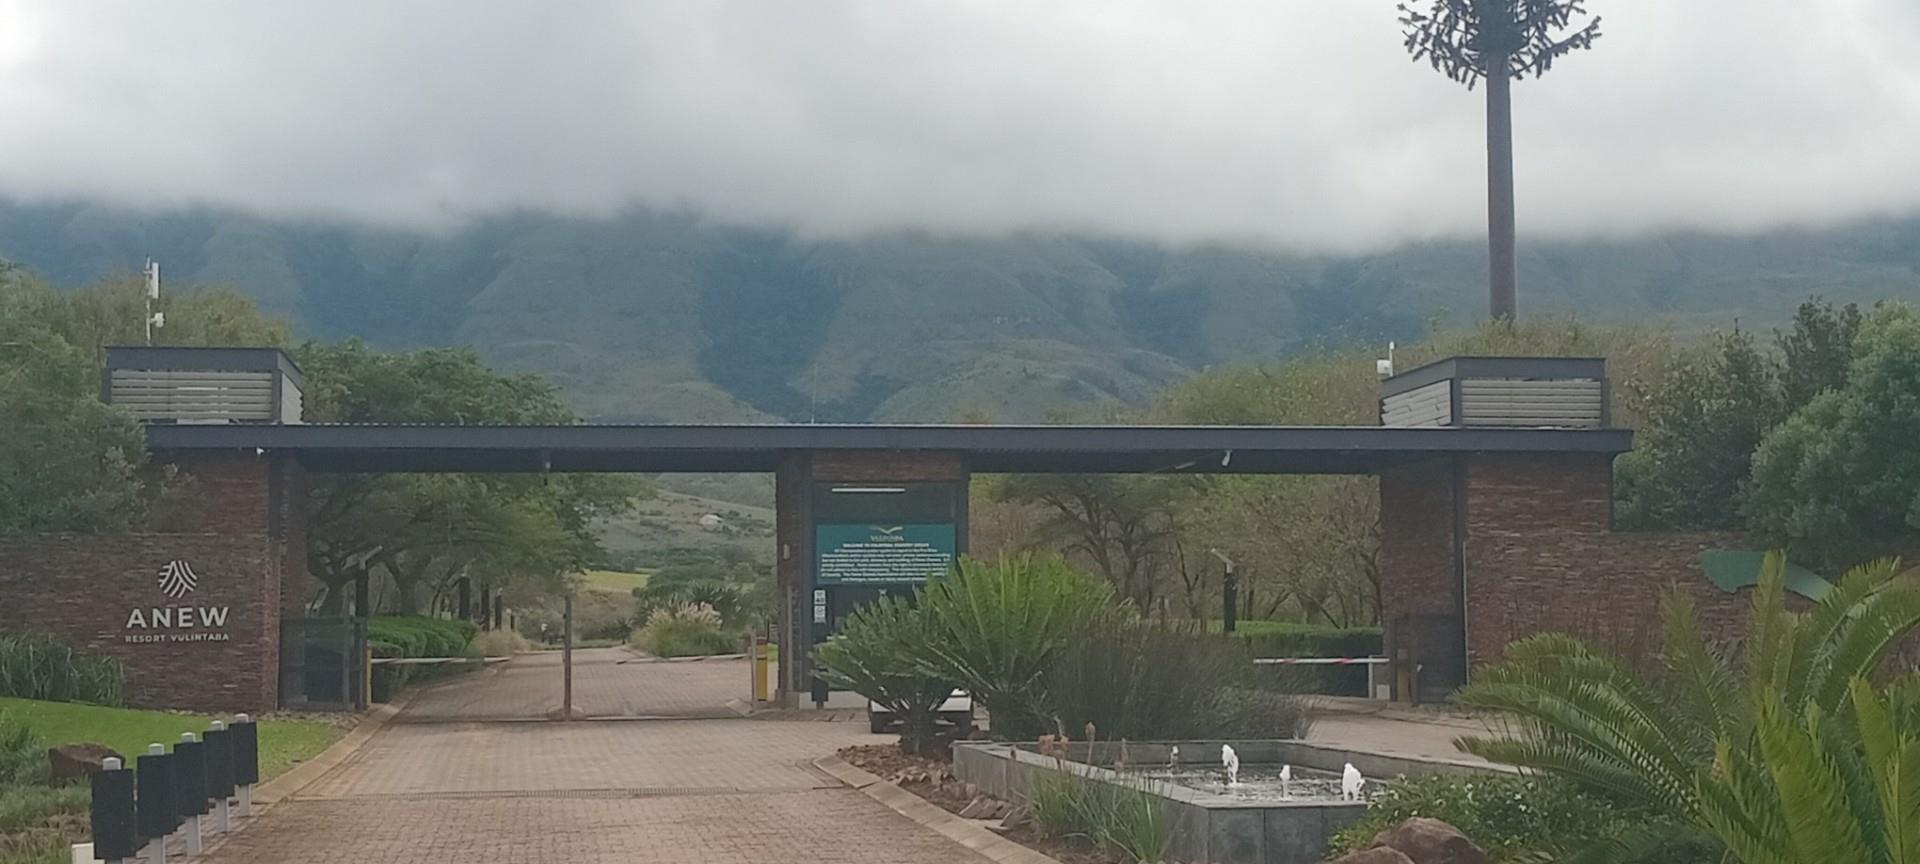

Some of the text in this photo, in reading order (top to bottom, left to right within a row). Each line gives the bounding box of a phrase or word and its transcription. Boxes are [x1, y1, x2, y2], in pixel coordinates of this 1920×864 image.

[126, 607, 229, 629] ANEW
[125, 633, 230, 643] RESORT VULINTABA
